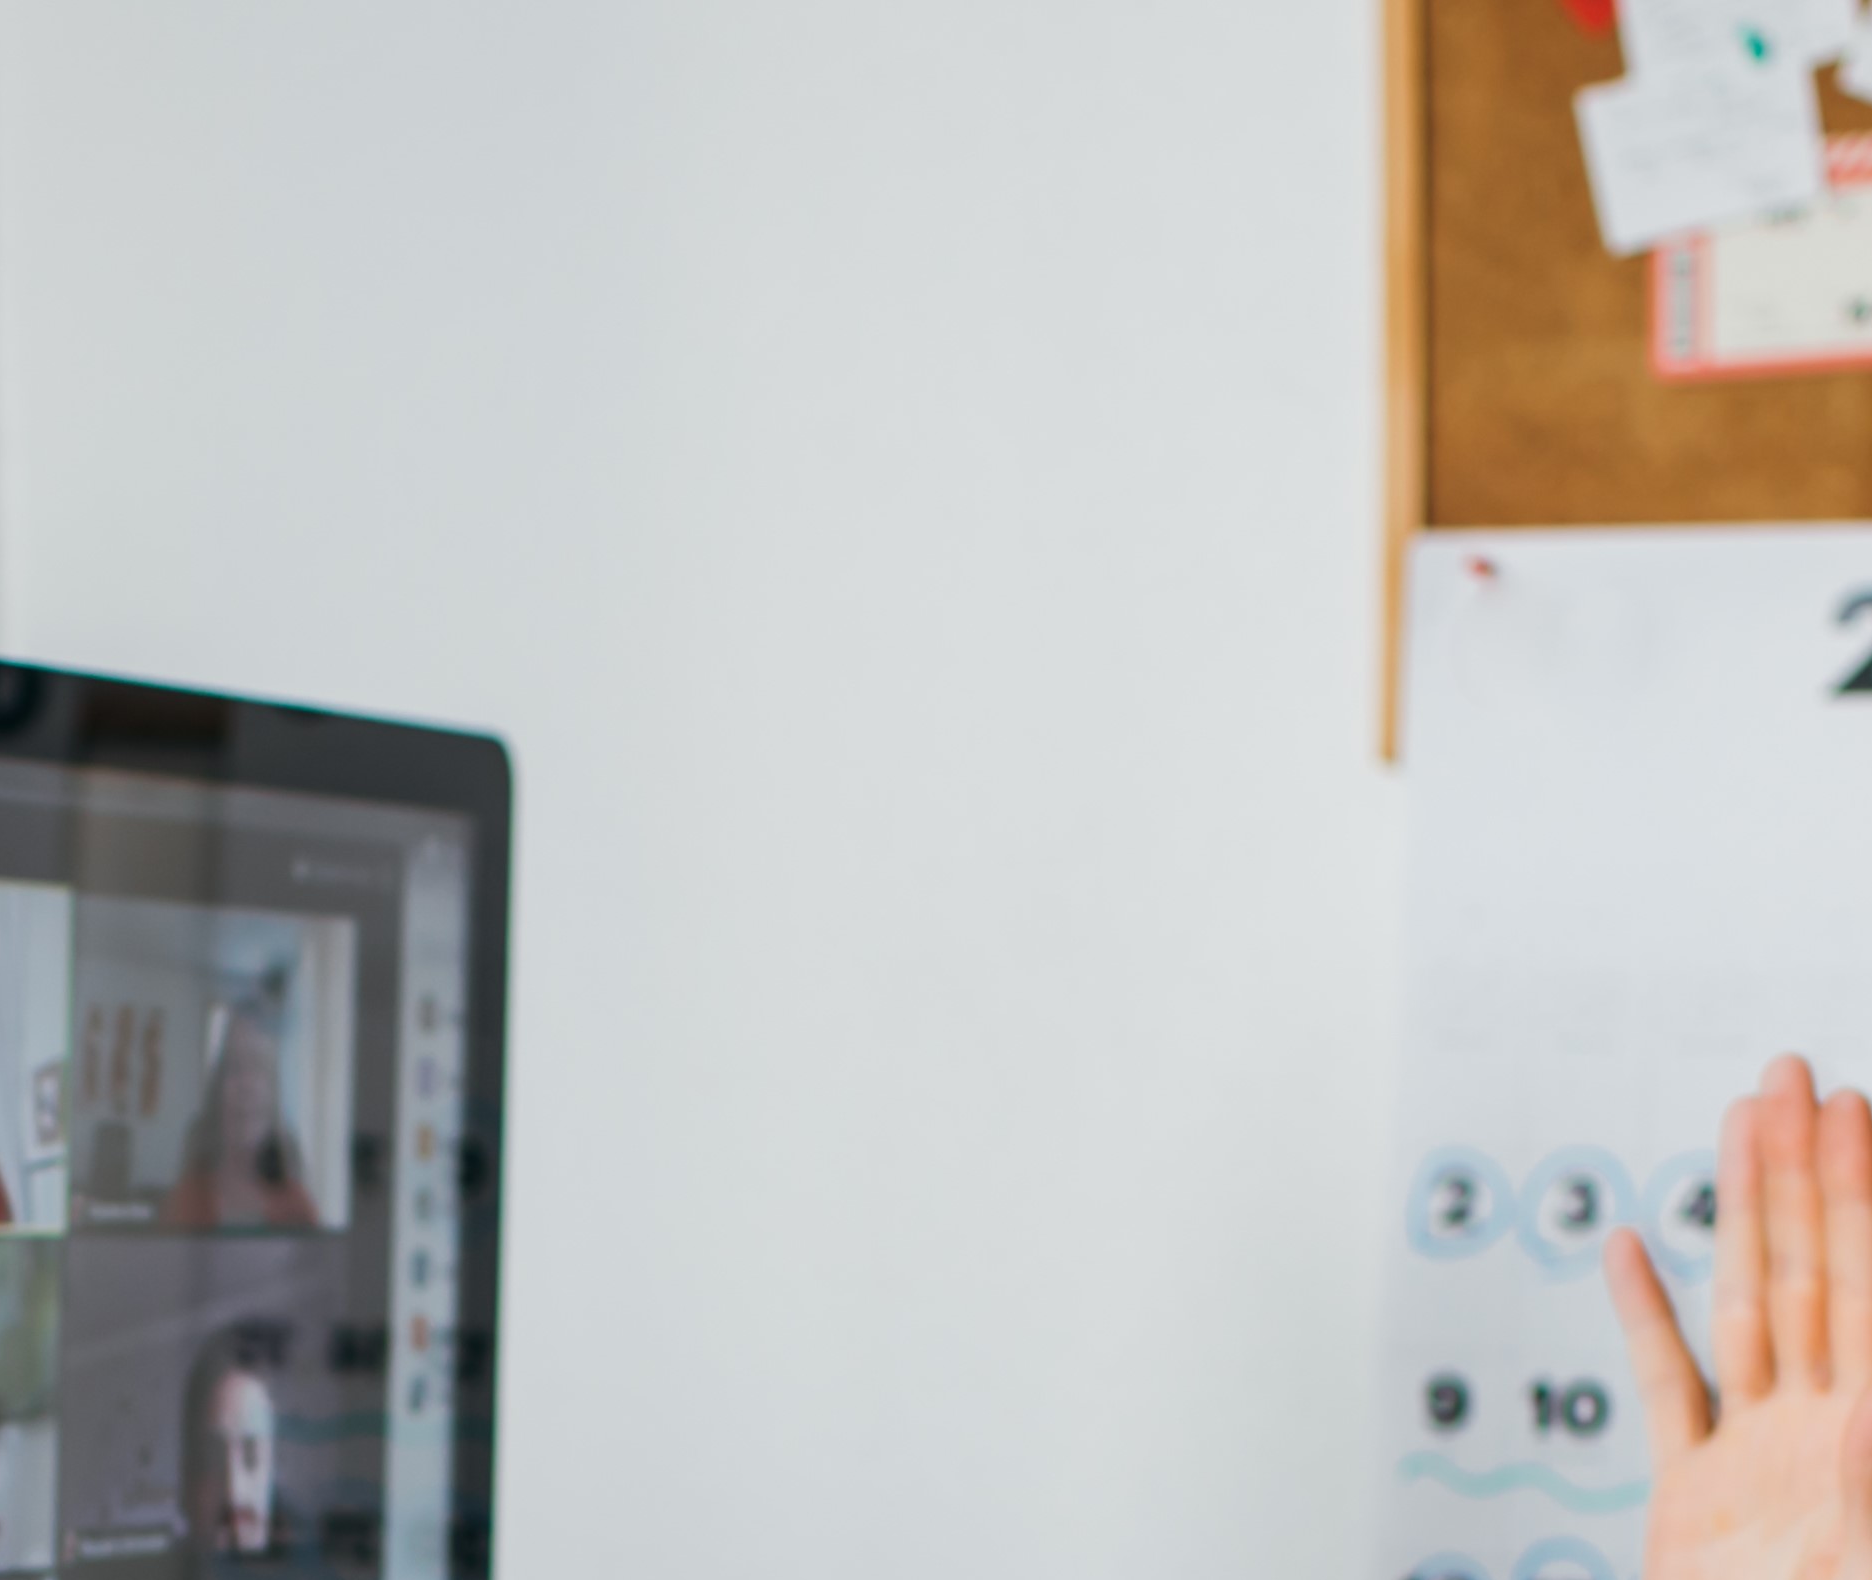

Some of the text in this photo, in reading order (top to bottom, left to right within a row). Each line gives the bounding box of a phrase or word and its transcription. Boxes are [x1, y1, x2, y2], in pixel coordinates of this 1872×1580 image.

[1440, 1175, 1477, 1229] 2
[1564, 1178, 1601, 1231] 3
[1422, 1372, 1475, 1435] 9
[1526, 1378, 1613, 1440] 10
